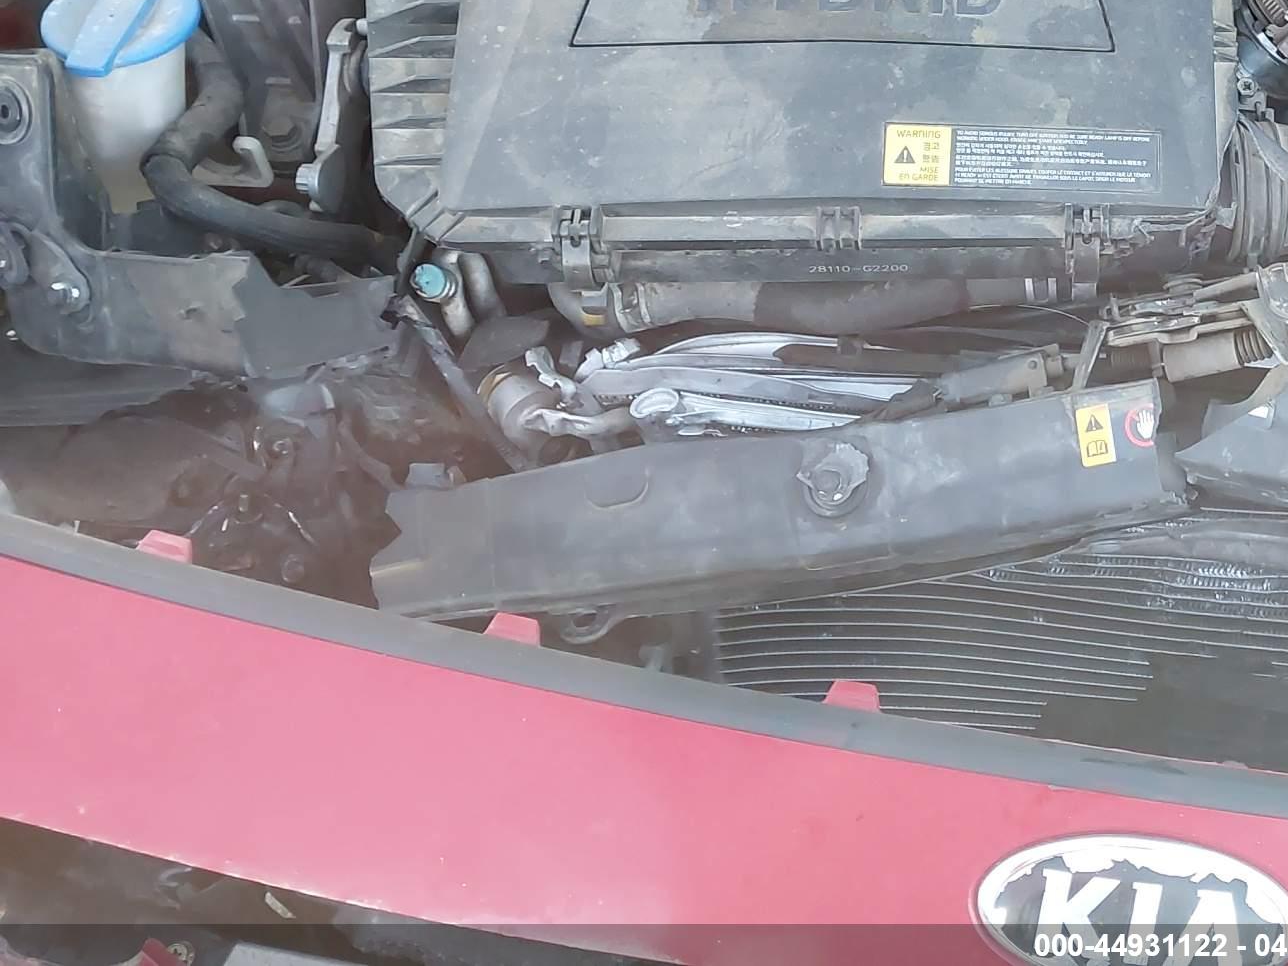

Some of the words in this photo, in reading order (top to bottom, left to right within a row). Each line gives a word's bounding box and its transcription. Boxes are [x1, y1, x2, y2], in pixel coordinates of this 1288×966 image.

[896, 129, 942, 139] WARNING
[808, 264, 909, 273] 28110-G2200
[1034, 868, 1243, 966] KIA
